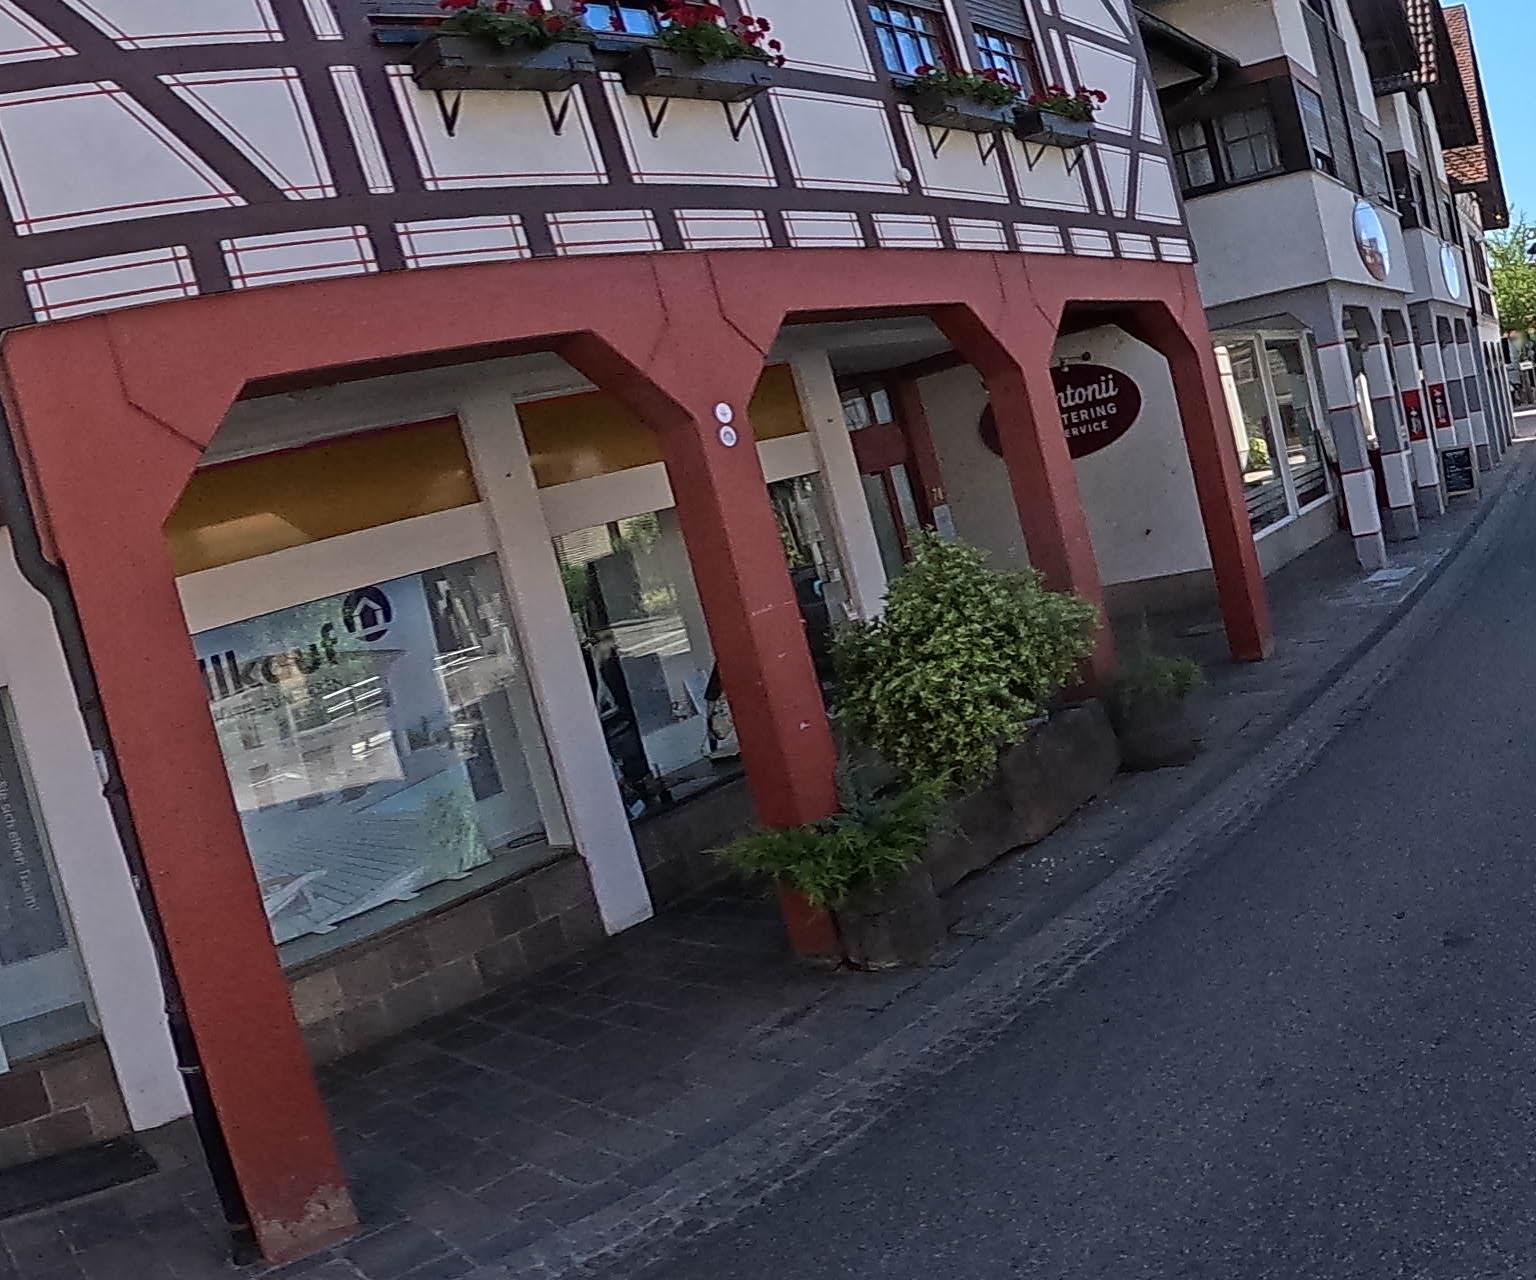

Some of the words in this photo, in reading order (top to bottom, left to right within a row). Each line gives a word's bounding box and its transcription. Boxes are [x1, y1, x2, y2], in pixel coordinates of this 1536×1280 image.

[1056, 374, 1119, 408] ntonii
[1061, 403, 1118, 425] TERING
[1064, 420, 1110, 438] ERVICE
[199, 622, 338, 700] llkauf
